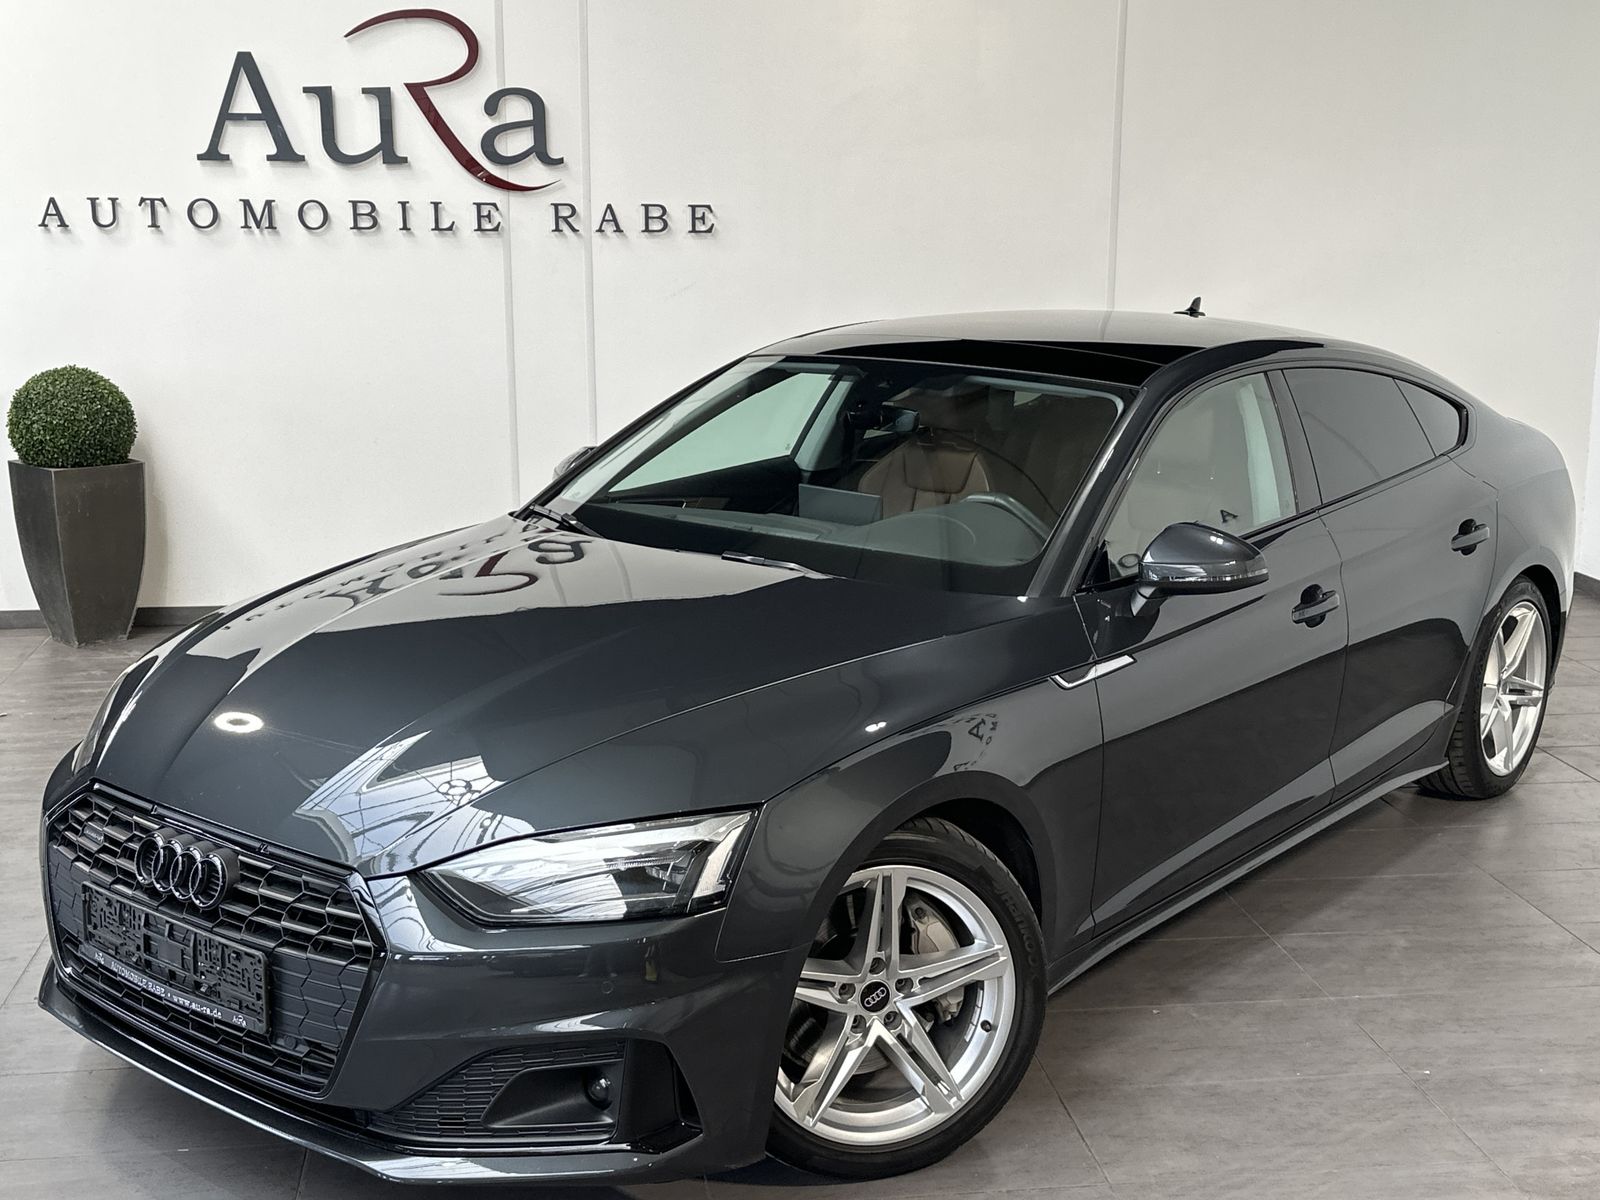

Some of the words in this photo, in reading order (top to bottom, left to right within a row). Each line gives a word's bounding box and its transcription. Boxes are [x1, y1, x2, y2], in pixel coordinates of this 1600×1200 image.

[197, 9, 564, 192] AuRa
[39, 197, 501, 233] AUTOMOBILE
[551, 203, 715, 234] RABE
